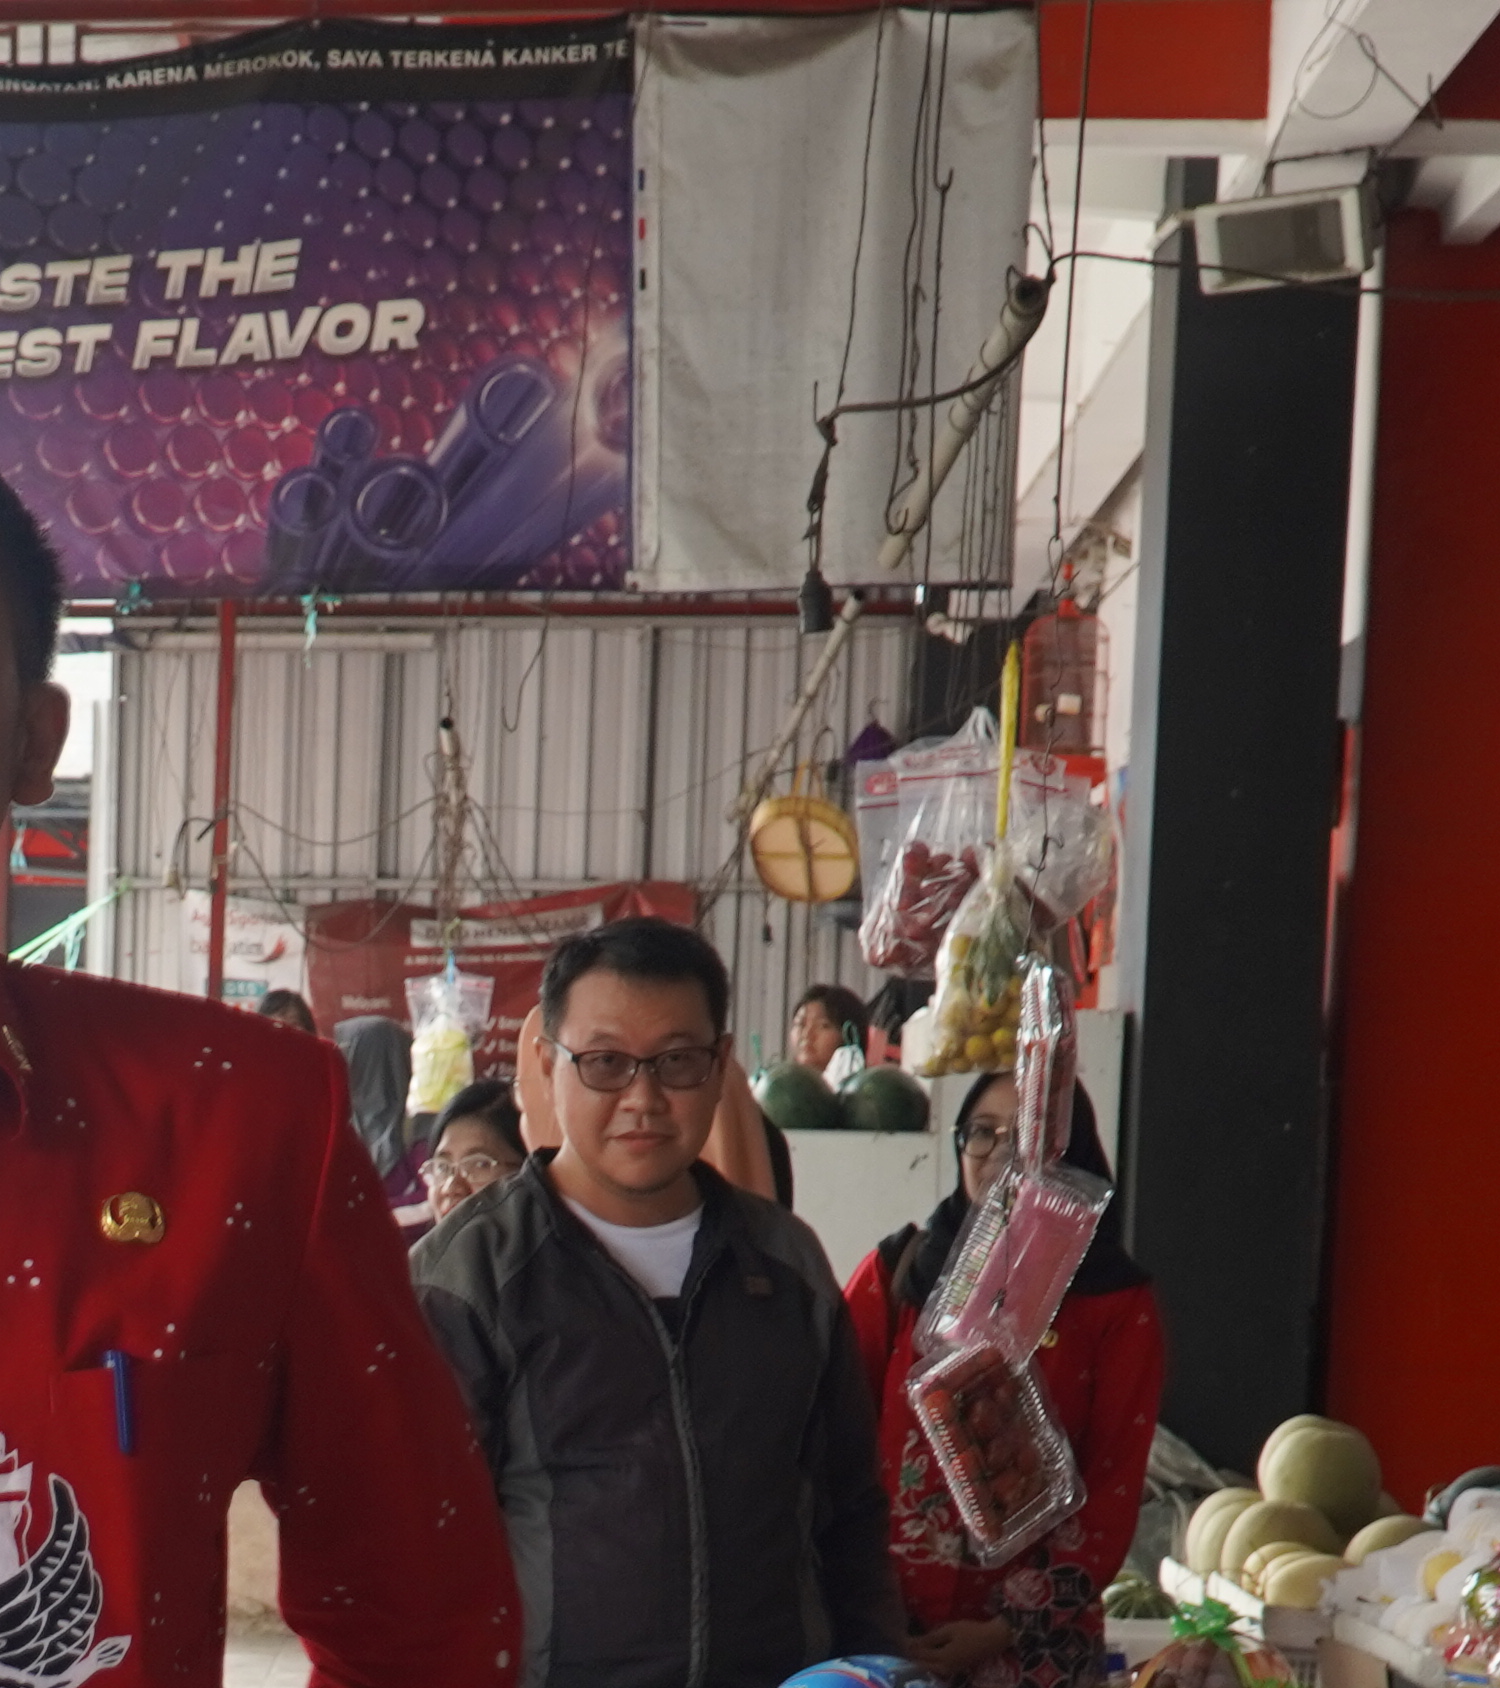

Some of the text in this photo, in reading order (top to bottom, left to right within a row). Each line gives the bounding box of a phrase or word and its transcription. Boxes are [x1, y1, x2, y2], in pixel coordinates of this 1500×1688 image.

[105, 66, 198, 90] KARENA
[202, 49, 321, 80] MEROKOK,
[326, 48, 384, 69] SAYA
[389, 48, 496, 69] TERKENA
[502, 42, 597, 67] KANKER
[155, 238, 303, 300] THE
[131, 298, 425, 371] FLAVOR
